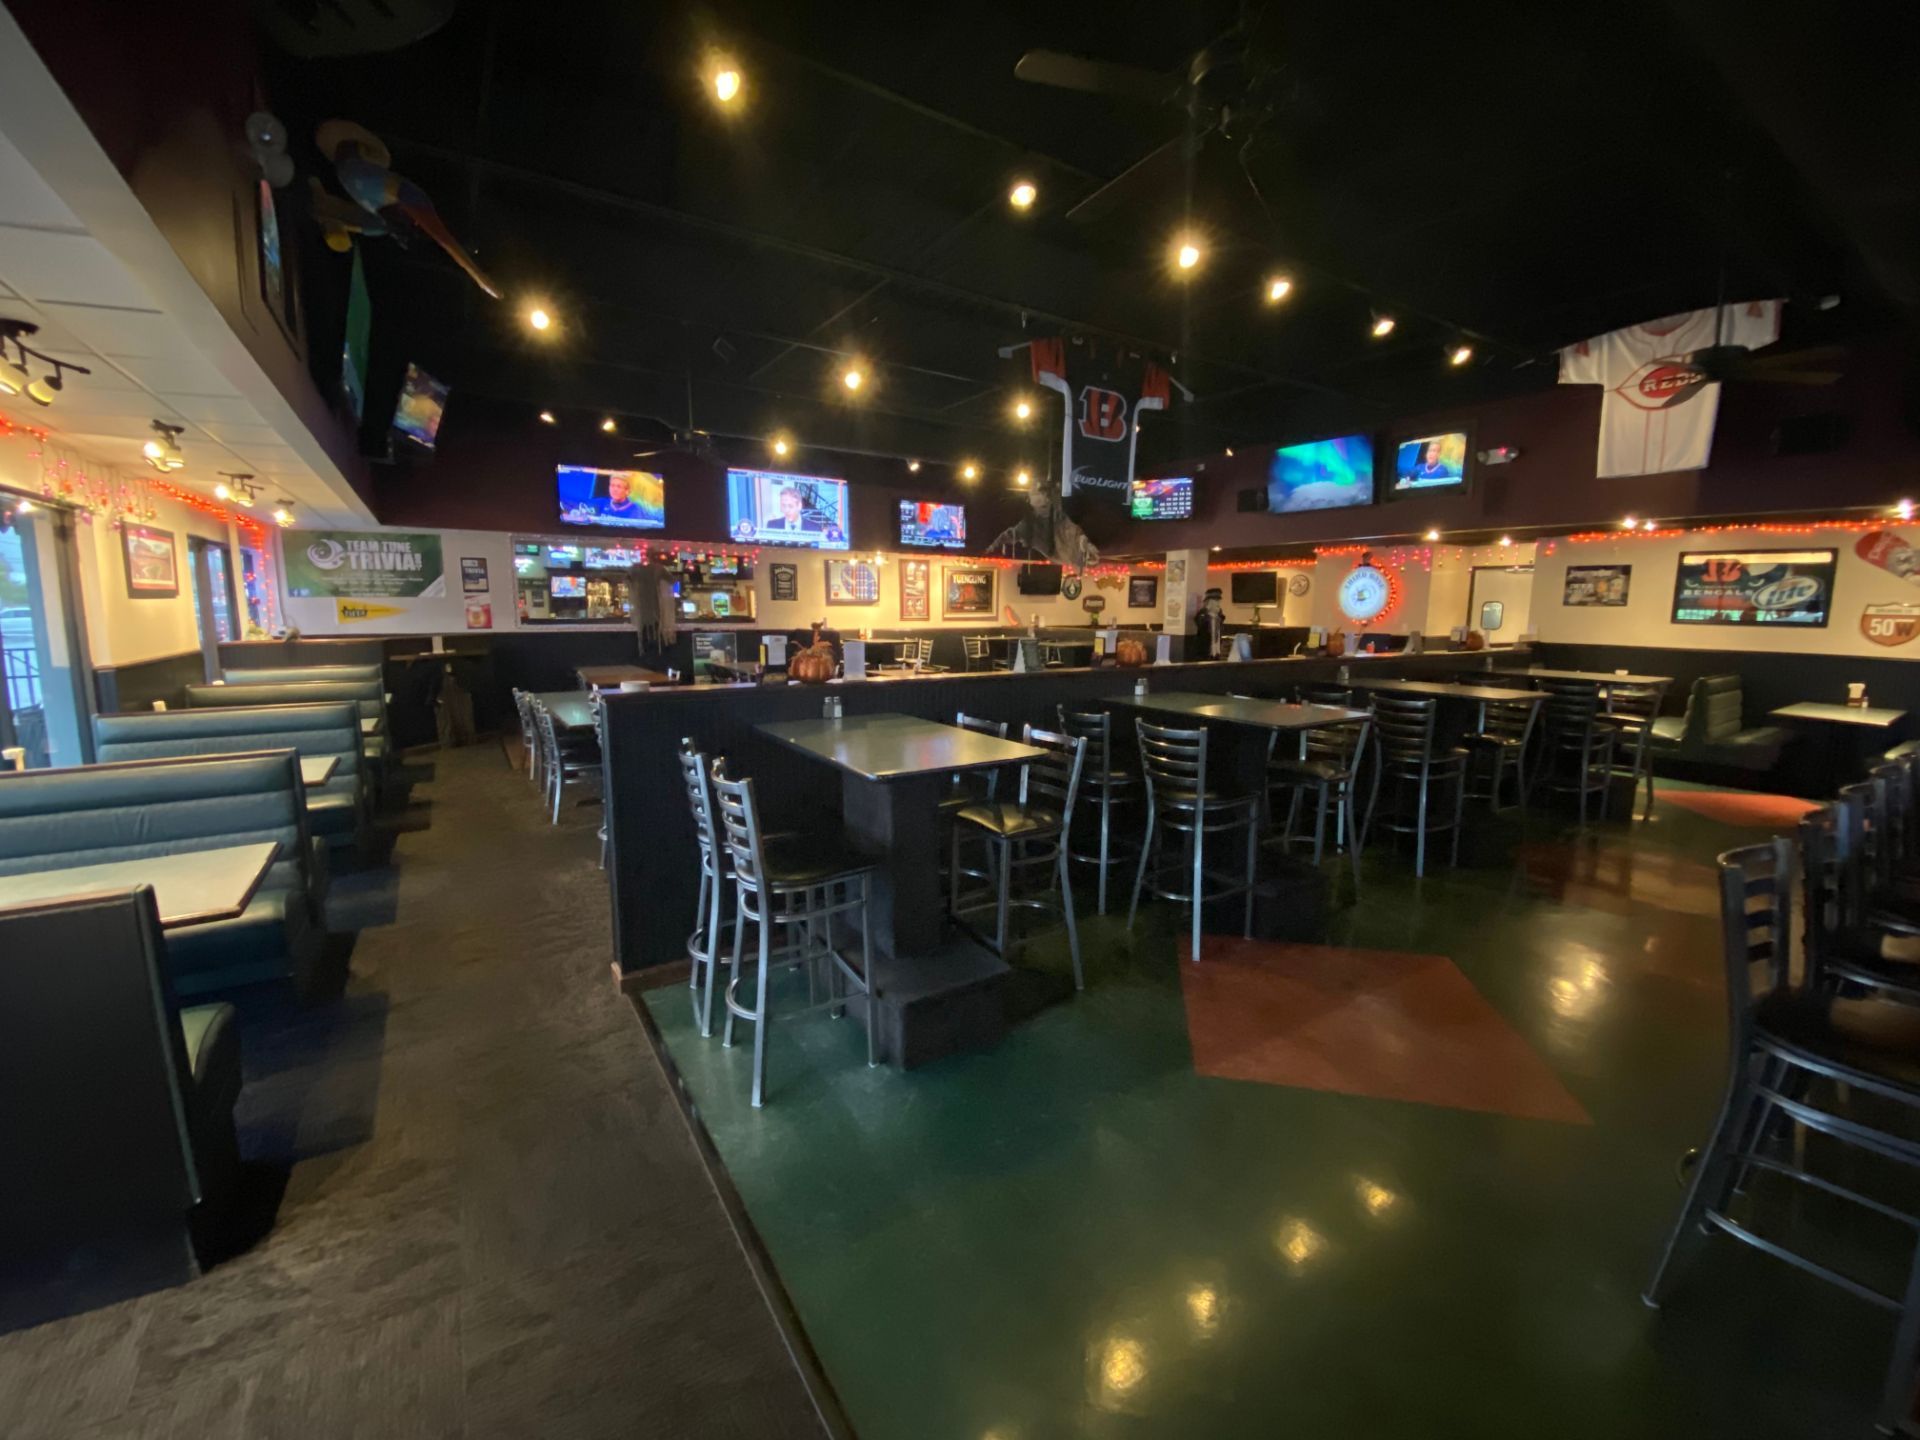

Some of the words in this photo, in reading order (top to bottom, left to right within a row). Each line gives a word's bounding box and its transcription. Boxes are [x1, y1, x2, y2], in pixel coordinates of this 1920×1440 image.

[1078, 385, 1127, 442] B
[1096, 477, 1129, 490] LIGHT
[345, 540, 380, 553] TEAM
[382, 541, 412, 553] TUNE
[1683, 588, 1753, 597] BENGALS
